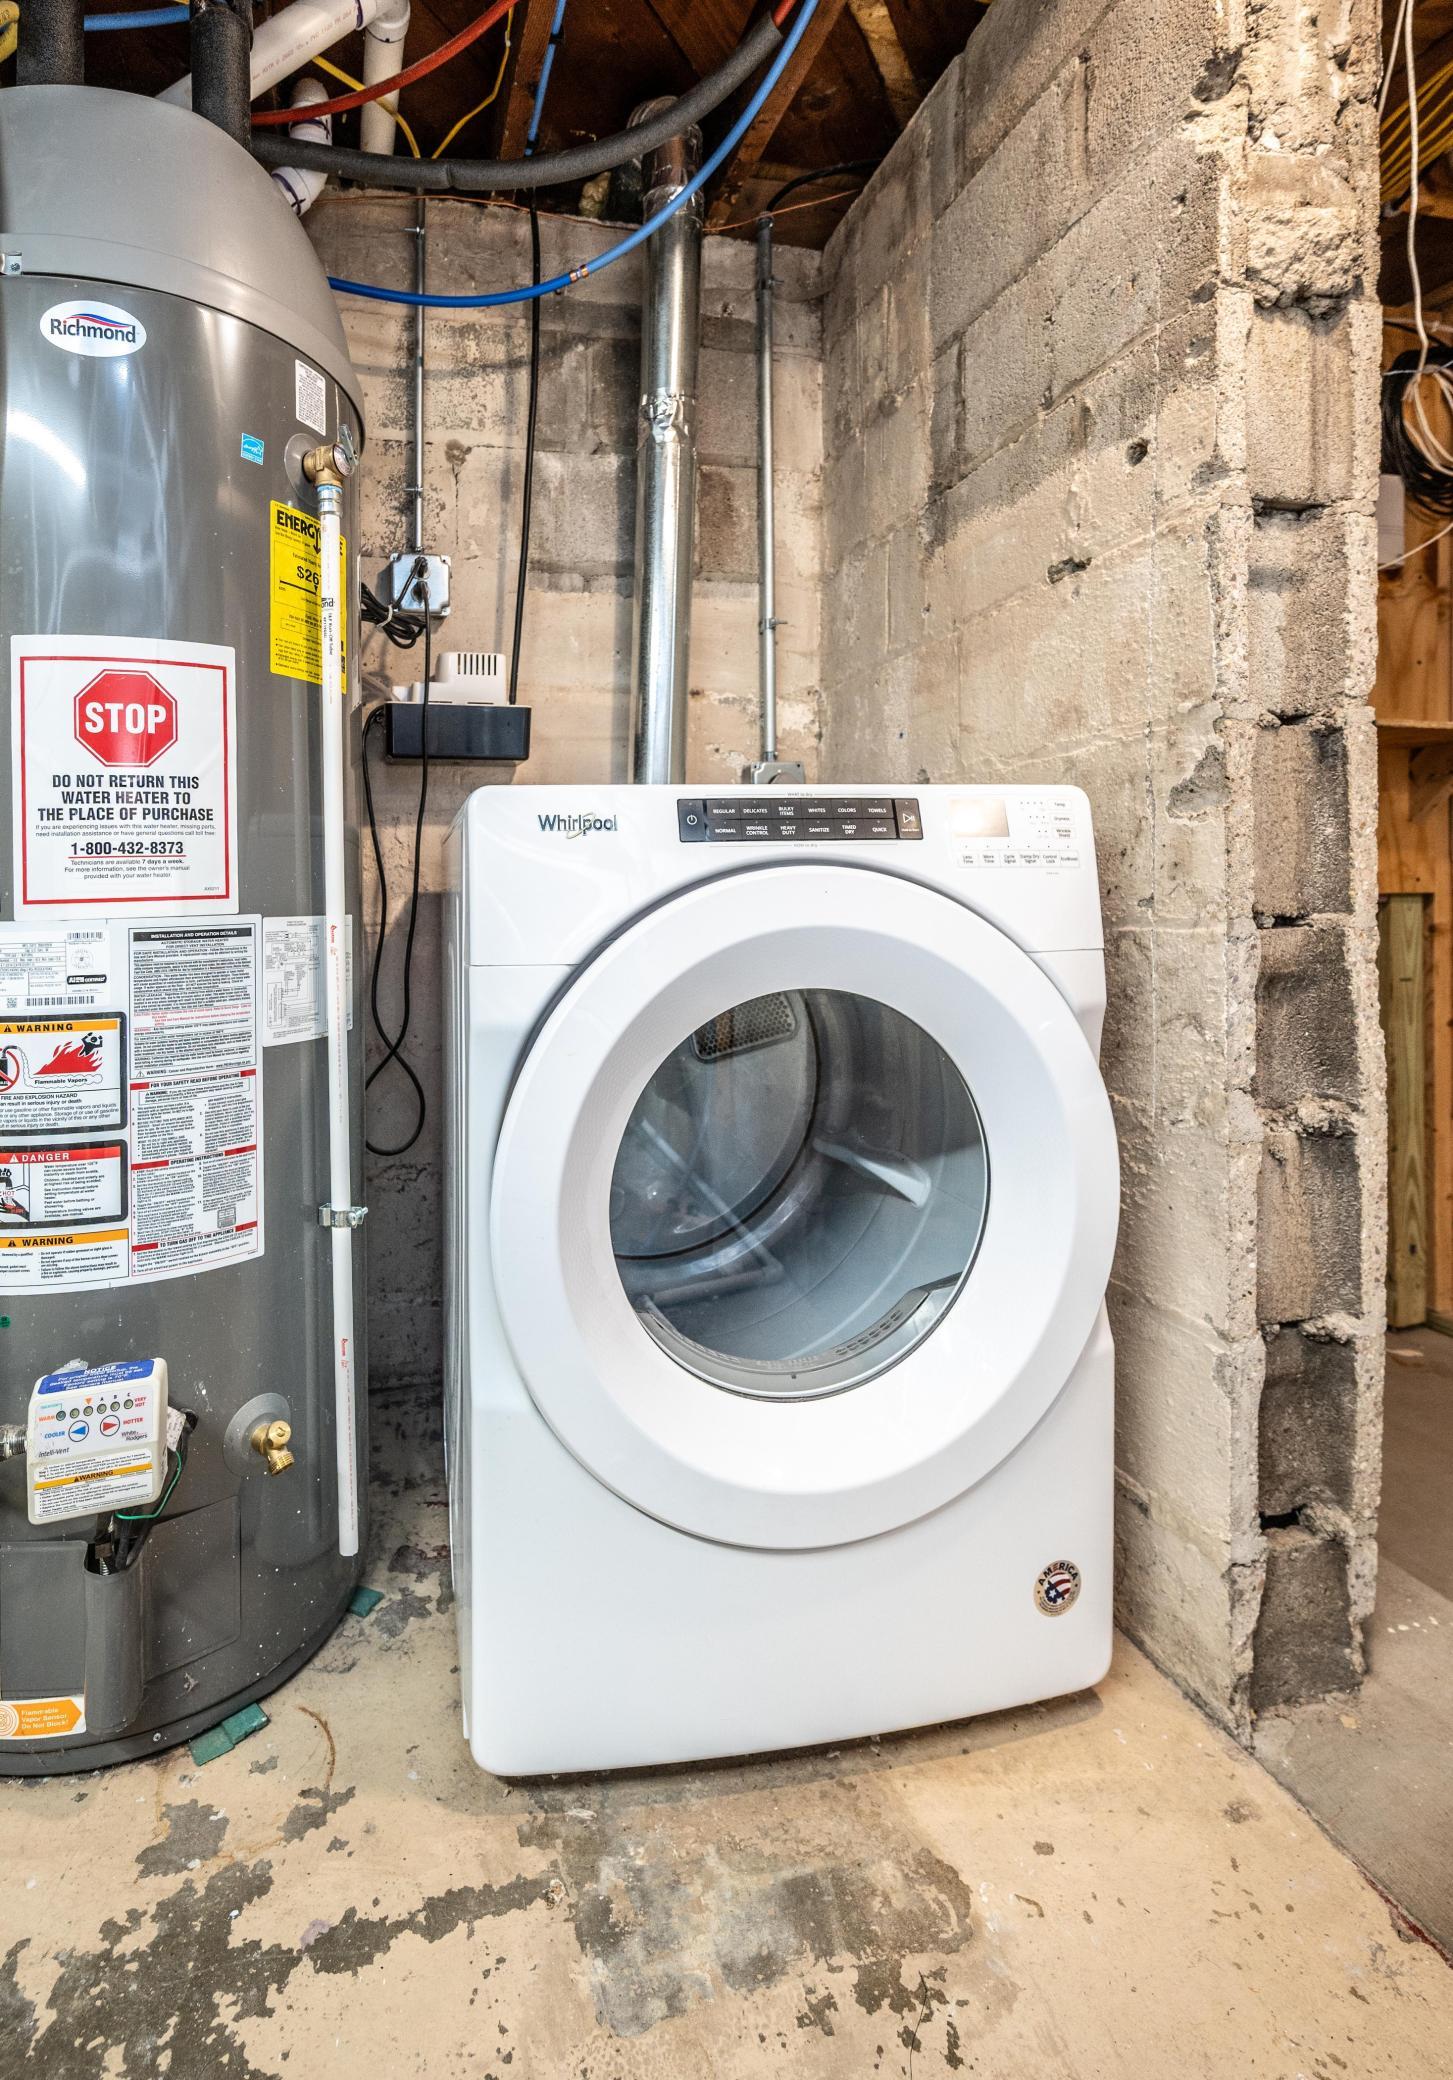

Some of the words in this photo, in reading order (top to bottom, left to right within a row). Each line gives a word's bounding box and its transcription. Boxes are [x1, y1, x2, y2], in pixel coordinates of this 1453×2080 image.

[50, 318, 136, 343] Richmond
[276, 509, 321, 539] ENERGY
[296, 565, 321, 585] $26
[85, 702, 167, 734] STOP
[52, 774, 71, 788] DO
[76, 774, 104, 788] NOT
[109, 775, 164, 788] RETURN
[169, 776, 199, 789] THIS
[61, 791, 110, 804] WATER
[115, 791, 168, 804] HEATER
[174, 791, 190, 804] TO
[38, 808, 63, 821] THE
[69, 808, 114, 821] PLACE
[119, 807, 136, 821] OF
[142, 807, 213, 821] PURCHASE
[538, 813, 618, 836] Whirlpool
[71, 841, 183, 855] 1-800-432-8373
[17, 1023, 73, 1032] WARNING
[22, 1153, 70, 1162] DANGER
[22, 1236, 74, 1247] WARNING
[84, 1366, 116, 1374] NOTICE
[123, 1417, 143, 1425] HOTTER
[44, 1431, 65, 1439] COOLER
[80, 1470, 113, 1481] WARNING
[1038, 1562, 1078, 1586] AMERICA
